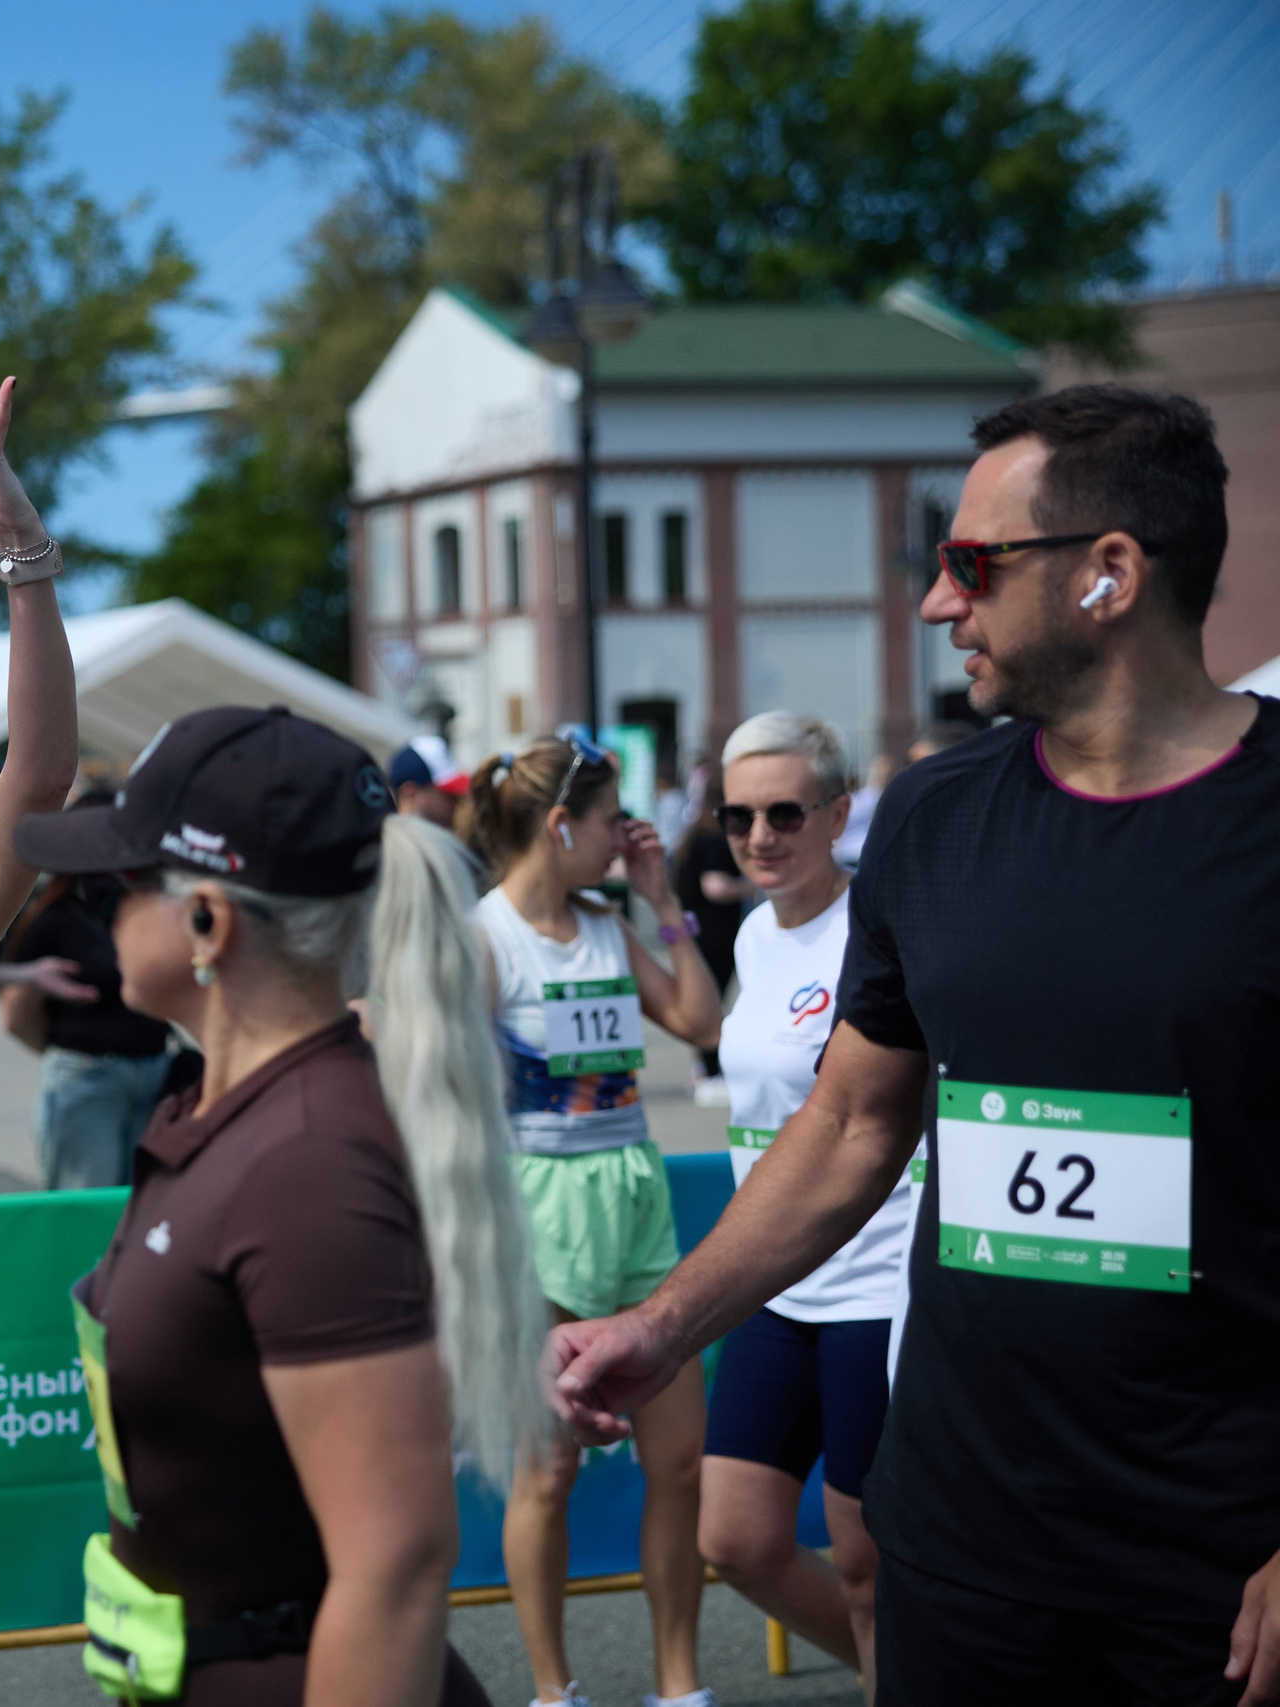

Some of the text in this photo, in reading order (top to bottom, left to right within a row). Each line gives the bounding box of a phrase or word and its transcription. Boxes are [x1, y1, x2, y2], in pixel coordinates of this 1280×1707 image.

[571, 1006, 621, 1045] 112
[1041, 1104, 1083, 1122] Звук
[1007, 1150, 1096, 1222] 62
[972, 1231, 995, 1265] A
